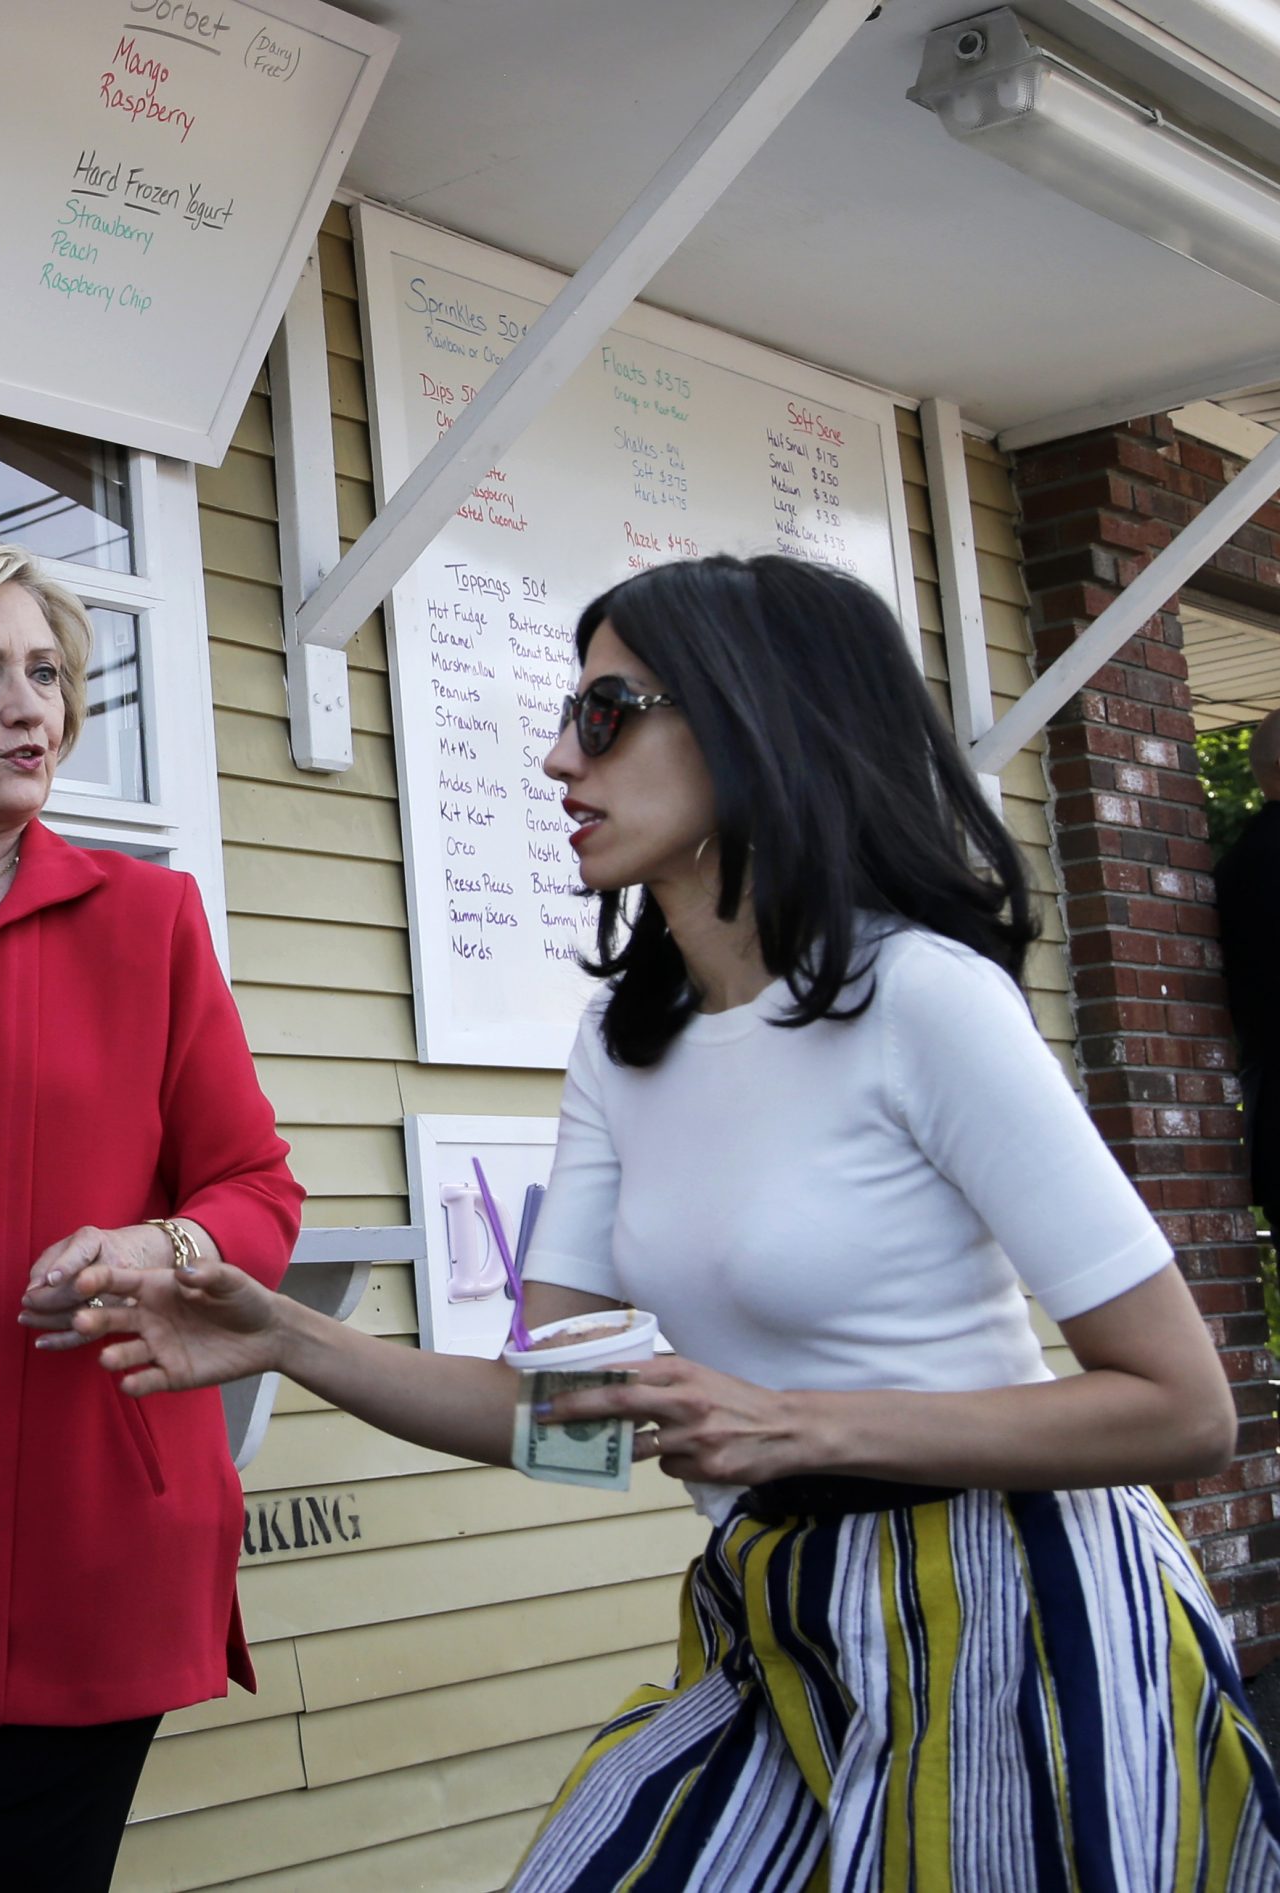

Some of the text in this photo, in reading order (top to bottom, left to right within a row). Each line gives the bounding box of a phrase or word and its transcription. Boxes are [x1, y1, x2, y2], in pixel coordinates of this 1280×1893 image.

[112, 36, 169, 97] Mango
[100, 72, 195, 143] Raspberry
[72, 150, 234, 231] Hard Frozen Yogurt
[57, 199, 154, 255] Strawberry
[51, 230, 98, 264] Peach
[39, 262, 152, 314] Raspberry Chip
[404, 278, 487, 331] Sprinkles
[602, 347, 647, 385] Floats
[419, 373, 478, 404] Dips 50
[787, 402, 845, 444] Soft Serve
[786, 437, 809, 460] Small
[769, 453, 794, 475] Small
[472, 486, 515, 513] aspberry
[771, 474, 801, 498] Medium
[489, 506, 527, 532] Coconut
[774, 496, 797, 523] Large
[624, 521, 661, 552] Razzle
[444, 564, 548, 602] Toppings 50¢
[427, 598, 488, 635] Hot Fudge
[430, 623, 475, 649] Caramel
[431, 651, 496, 679] Marshmallow
[508, 637, 576, 665] Peanut Butter
[431, 679, 481, 702] Peanuts
[512, 665, 578, 691] Whipped Crea
[517, 693, 560, 715] Walnuts
[435, 705, 499, 744] Strawberry
[519, 716, 560, 747] Pineapp
[439, 770, 507, 799] Andes Mints
[520, 778, 555, 801] Peanut
[439, 800, 495, 826] Kit Kat
[525, 808, 573, 833] Granola
[446, 836, 475, 856] Oreo
[528, 841, 561, 863] Nestle
[445, 869, 514, 895] Reeses Pieces
[448, 899, 518, 932] Gummy Bears
[540, 904, 578, 934] Gummy
[452, 935, 493, 960] Nerds
